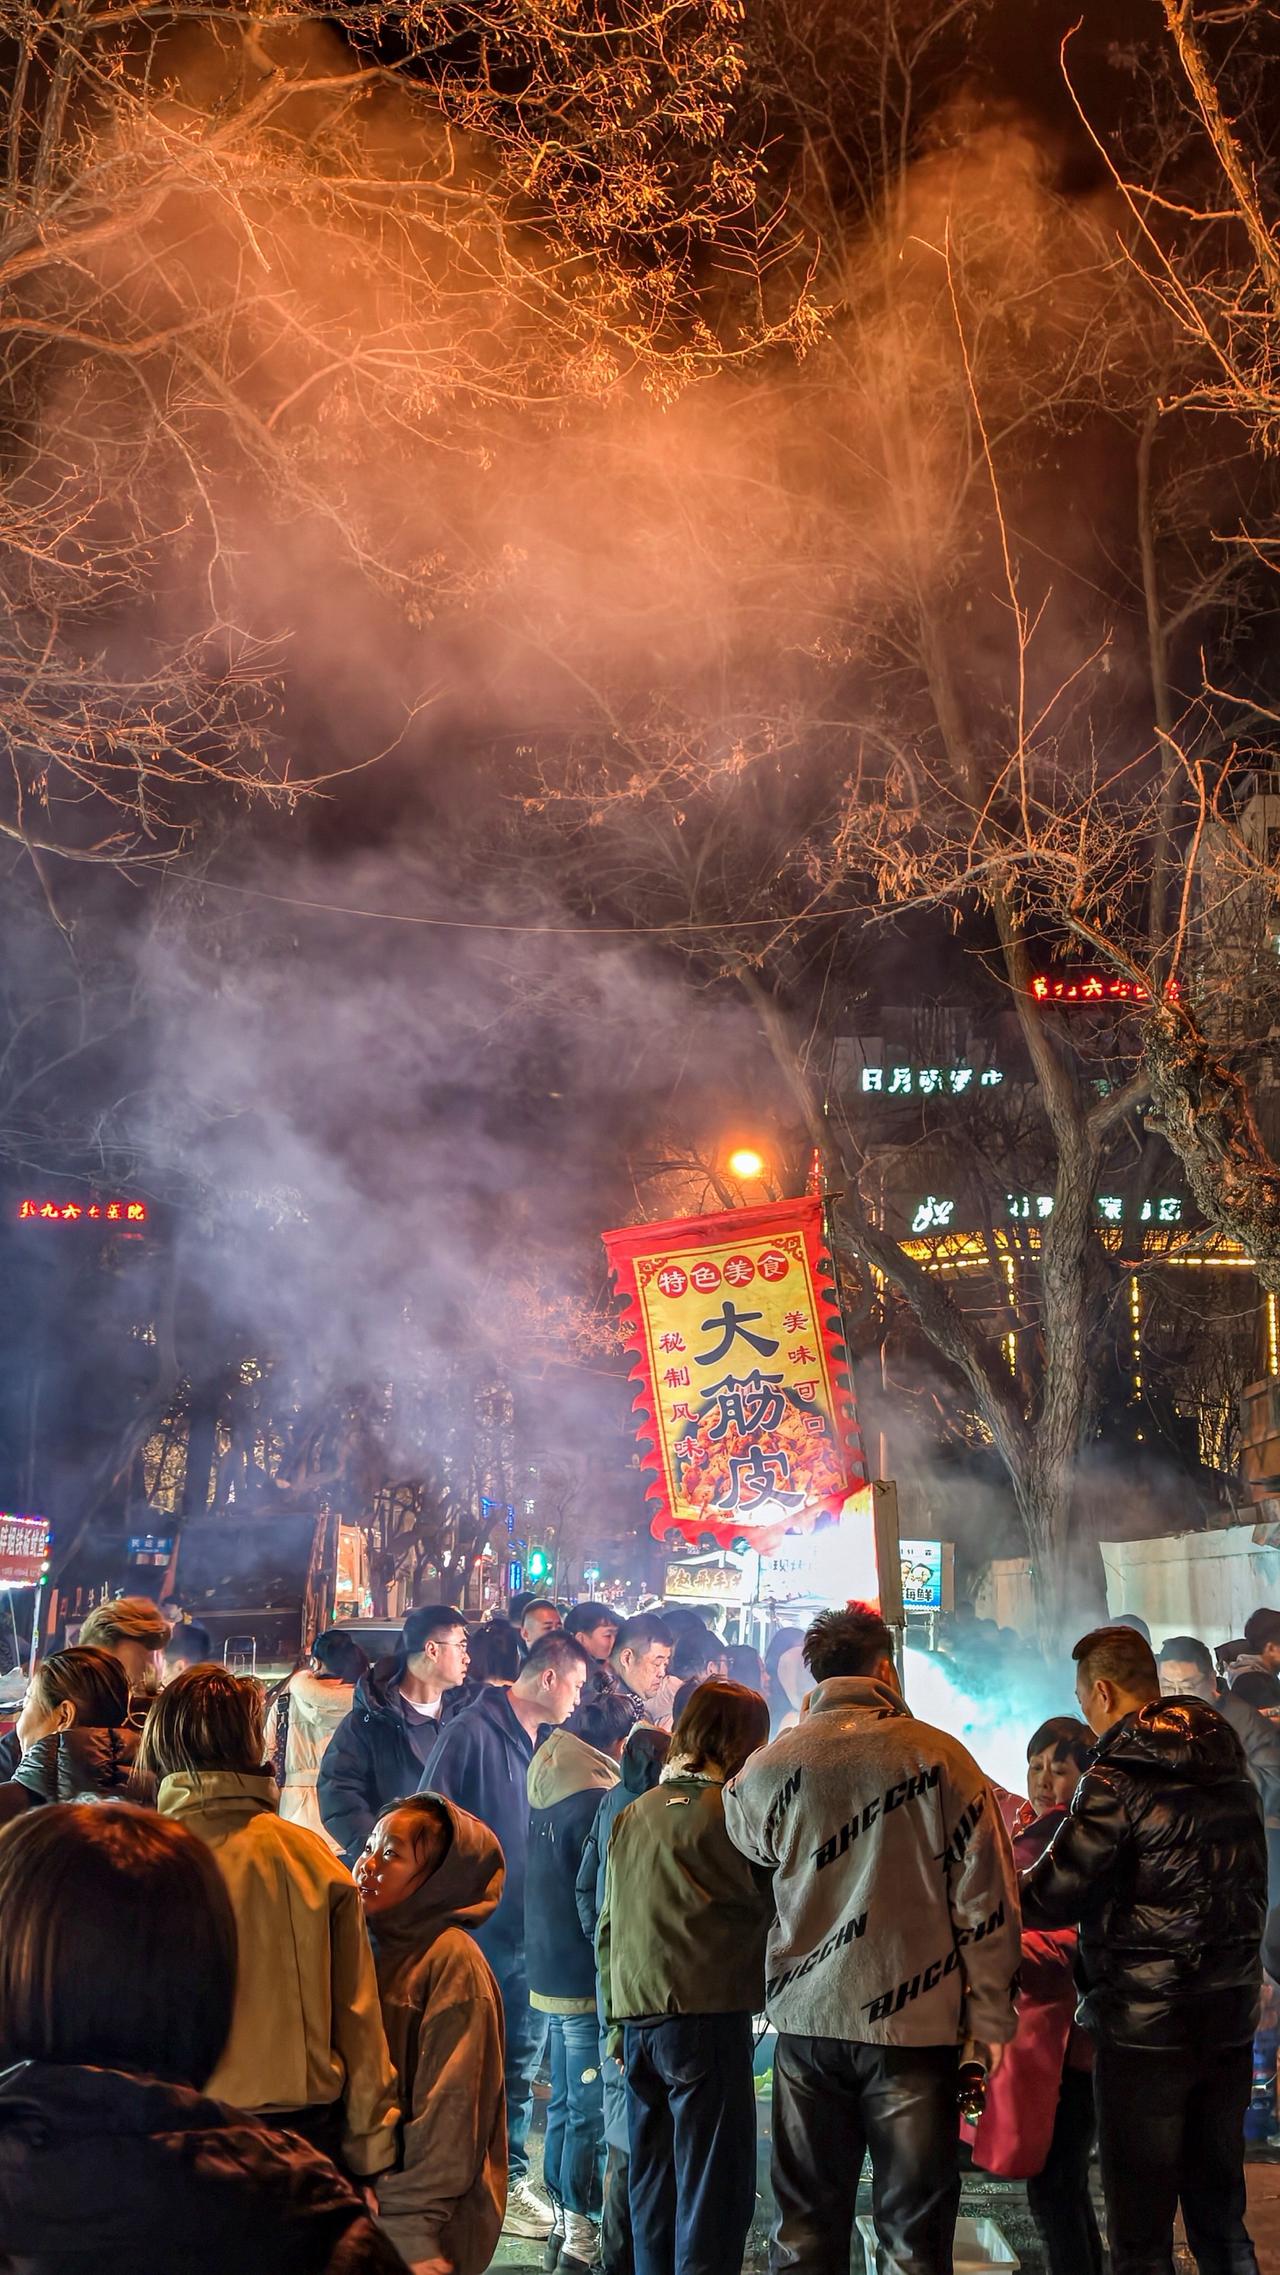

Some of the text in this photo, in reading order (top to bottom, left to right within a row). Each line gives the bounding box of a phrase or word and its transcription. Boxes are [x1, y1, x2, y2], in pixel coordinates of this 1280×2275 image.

[659, 1253, 788, 1295] 特色美食
[658, 1332, 704, 1460] 秘制风味
[694, 1300, 806, 1512] 大筋皮
[782, 1311, 825, 1434] 美味可口
